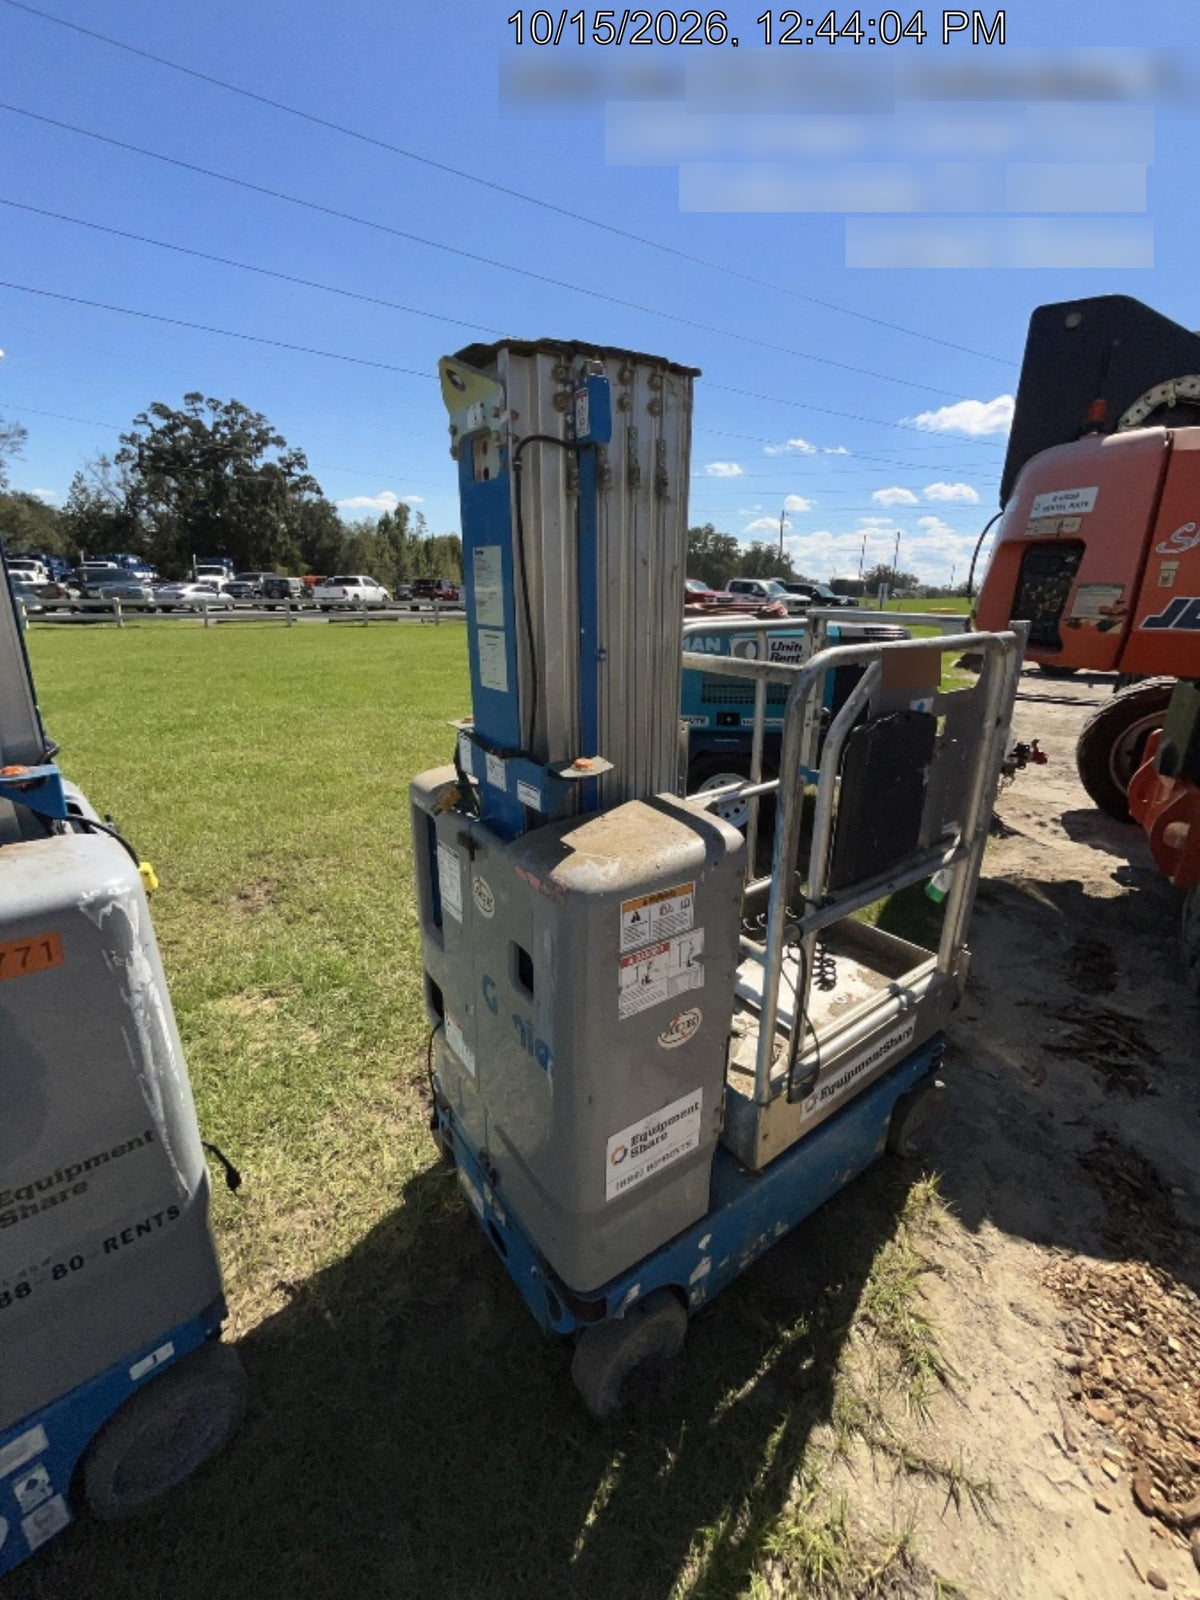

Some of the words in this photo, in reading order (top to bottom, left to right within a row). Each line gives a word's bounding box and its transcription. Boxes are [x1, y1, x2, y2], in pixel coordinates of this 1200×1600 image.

[630, 1101, 701, 1148] Equipment
[630, 1132, 668, 1159] Share
[0, 1181, 89, 1229] Share
[103, 1205, 181, 1254] RENTS
